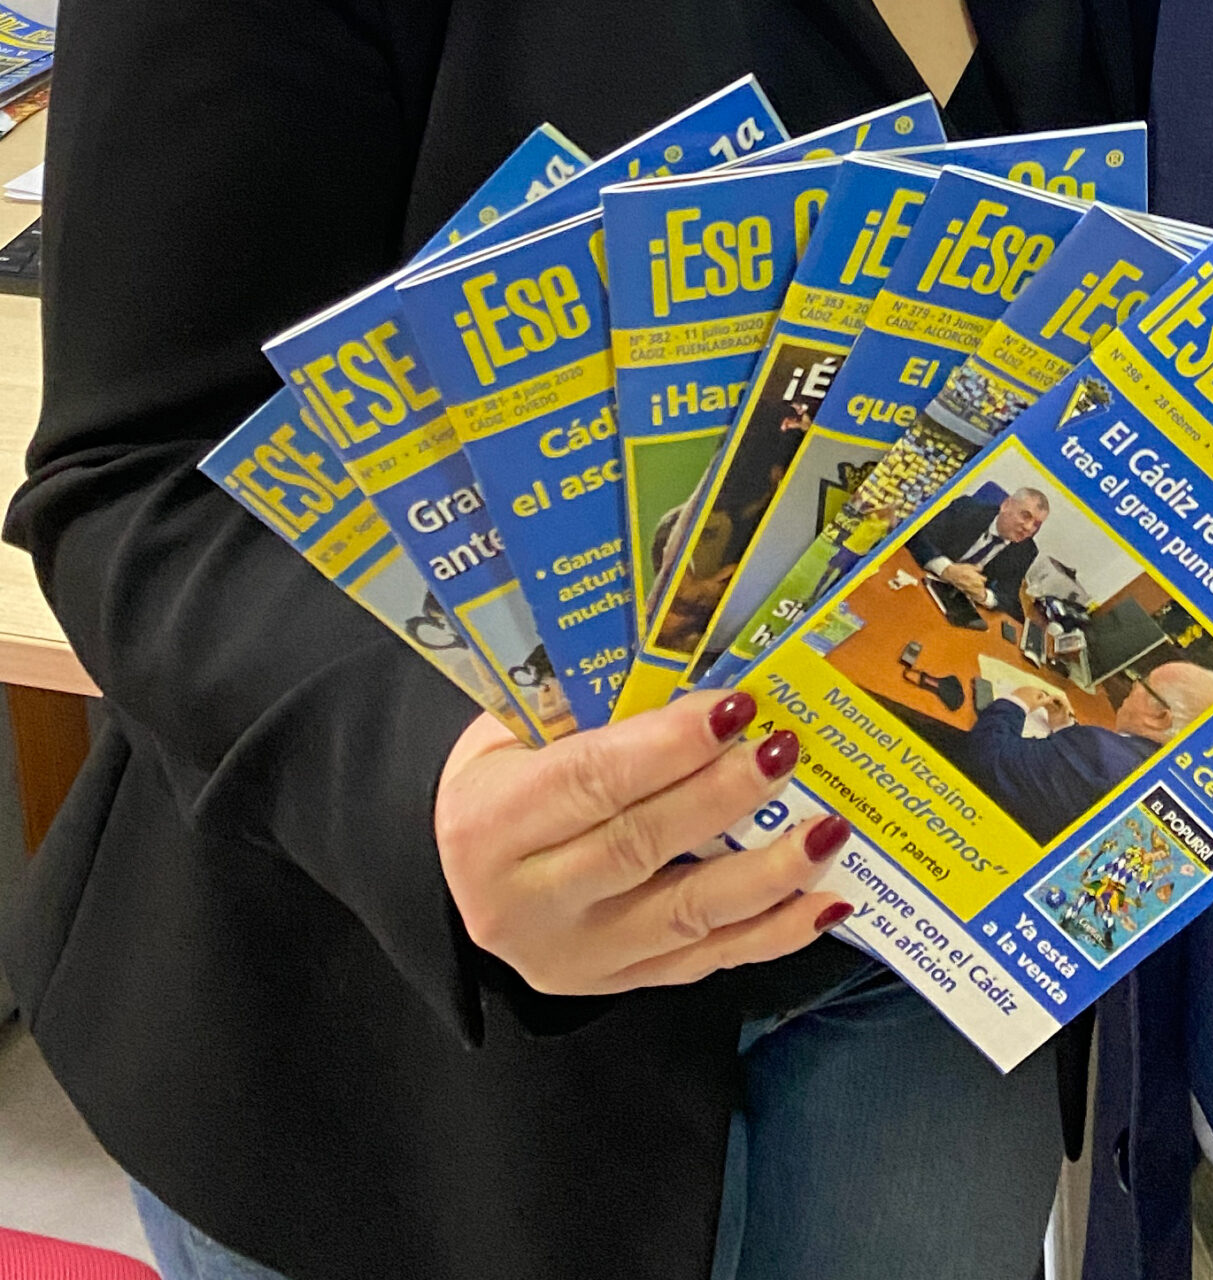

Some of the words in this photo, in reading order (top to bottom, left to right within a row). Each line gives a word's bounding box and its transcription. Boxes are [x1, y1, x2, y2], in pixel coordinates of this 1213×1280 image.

[649, 207, 773, 318] ¡Ese
[453, 265, 591, 387] ¡Ese
[733, 318, 765, 333] 2020
[909, 304, 931, 318] 379
[289, 319, 443, 450] ¡ESE
[899, 356, 941, 389] El
[538, 406, 617, 459] Cád
[846, 393, 917, 427] que
[1154, 394, 1170, 412] 28
[1166, 407, 1202, 442] Febrero
[224, 422, 357, 542] ¡ESE
[1060, 434, 1104, 480] tras
[1099, 420, 1139, 457] El
[1128, 448, 1200, 520] Cádiz
[407, 483, 486, 534] Gra
[511, 479, 551, 518] el
[1099, 474, 1130, 499] el
[1114, 491, 1171, 542] gran
[558, 561, 632, 603] asturi
[578, 646, 628, 675] Sólo
[588, 677, 603, 695] 7
[823, 686, 904, 754] Manuel
[899, 746, 984, 828] Vizcaíno:
[1174, 750, 1194, 770] a
[811, 761, 884, 826] entrevista
[901, 840, 951, 882] parte)
[840, 850, 916, 920] Siempre
[914, 917, 950, 952] con
[948, 947, 974, 968] el
[967, 964, 1018, 1016] Cádiz
[853, 901, 875, 919] y
[870, 914, 898, 940] su
[894, 933, 958, 995] afición
[1013, 911, 1038, 942] Ya
[1036, 937, 1080, 980] está
[981, 919, 999, 938] a
[996, 931, 1019, 956] la
[1016, 952, 1069, 1006] venta
